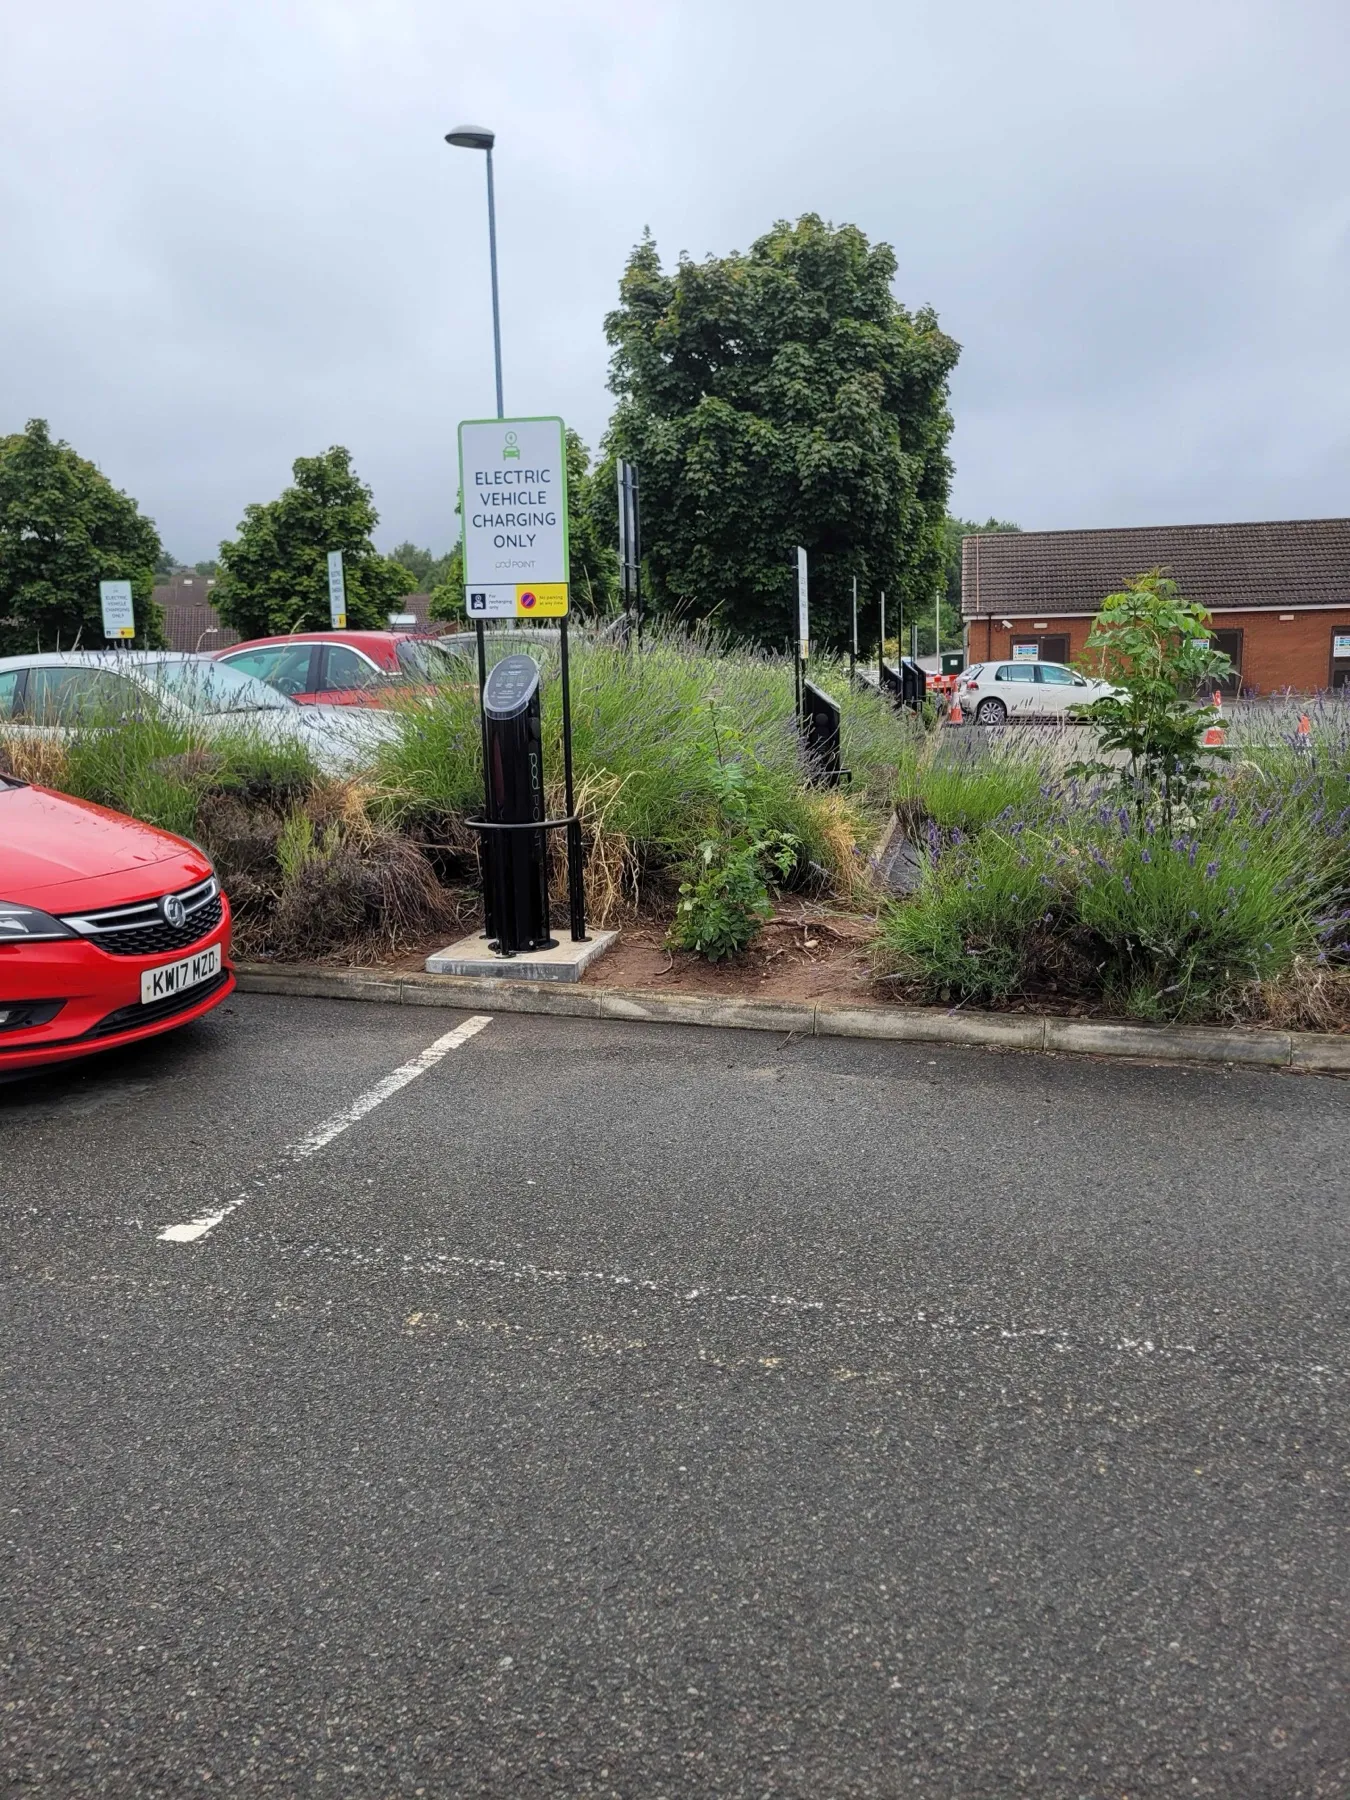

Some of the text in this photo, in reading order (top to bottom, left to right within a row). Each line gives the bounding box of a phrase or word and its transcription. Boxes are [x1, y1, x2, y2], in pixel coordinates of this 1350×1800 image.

[475, 469, 551, 486] ELECTRIC
[480, 490, 547, 507] VEHICLE
[472, 511, 556, 529] CHARGING
[493, 533, 537, 549] ONLY
[511, 559, 537, 569] POINT
[528, 752, 540, 790] pod
[153, 962, 189, 997] KW17
[192, 950, 215, 982] MZD
